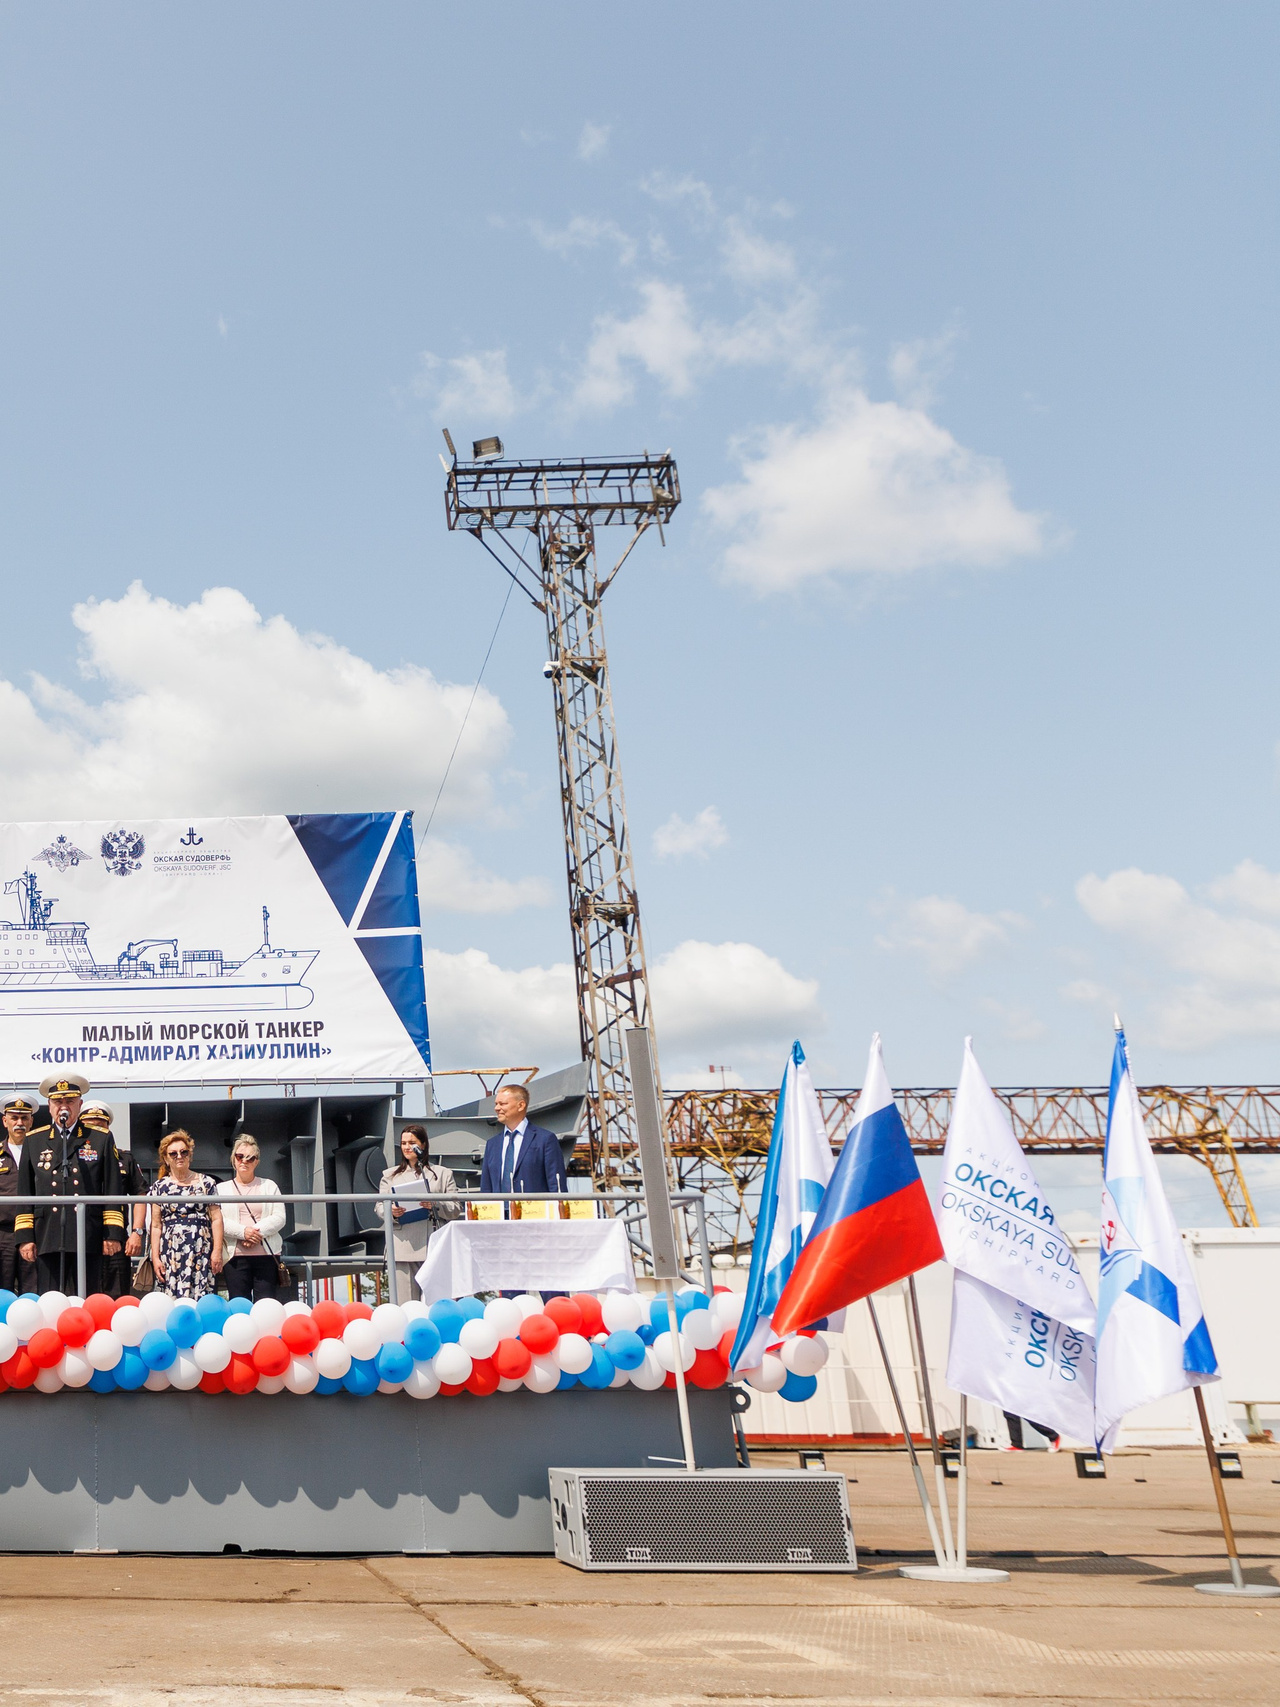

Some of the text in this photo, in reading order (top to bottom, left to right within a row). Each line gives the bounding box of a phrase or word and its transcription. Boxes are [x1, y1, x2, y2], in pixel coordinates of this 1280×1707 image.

[153, 854, 231, 863] ОКСКАЯ СУДОВЕРФЬ
[82, 1019, 325, 1042] МАЛЫЙ МОРСКОЙ ТАНКЕР
[31, 1042, 332, 1065] «КОНТР-АДМИРАЛ ХАЛИУЛЛИН»
[954, 1163, 1055, 1226] ОКСКАЯ
[941, 1192, 1035, 1251] OKSKAYA
